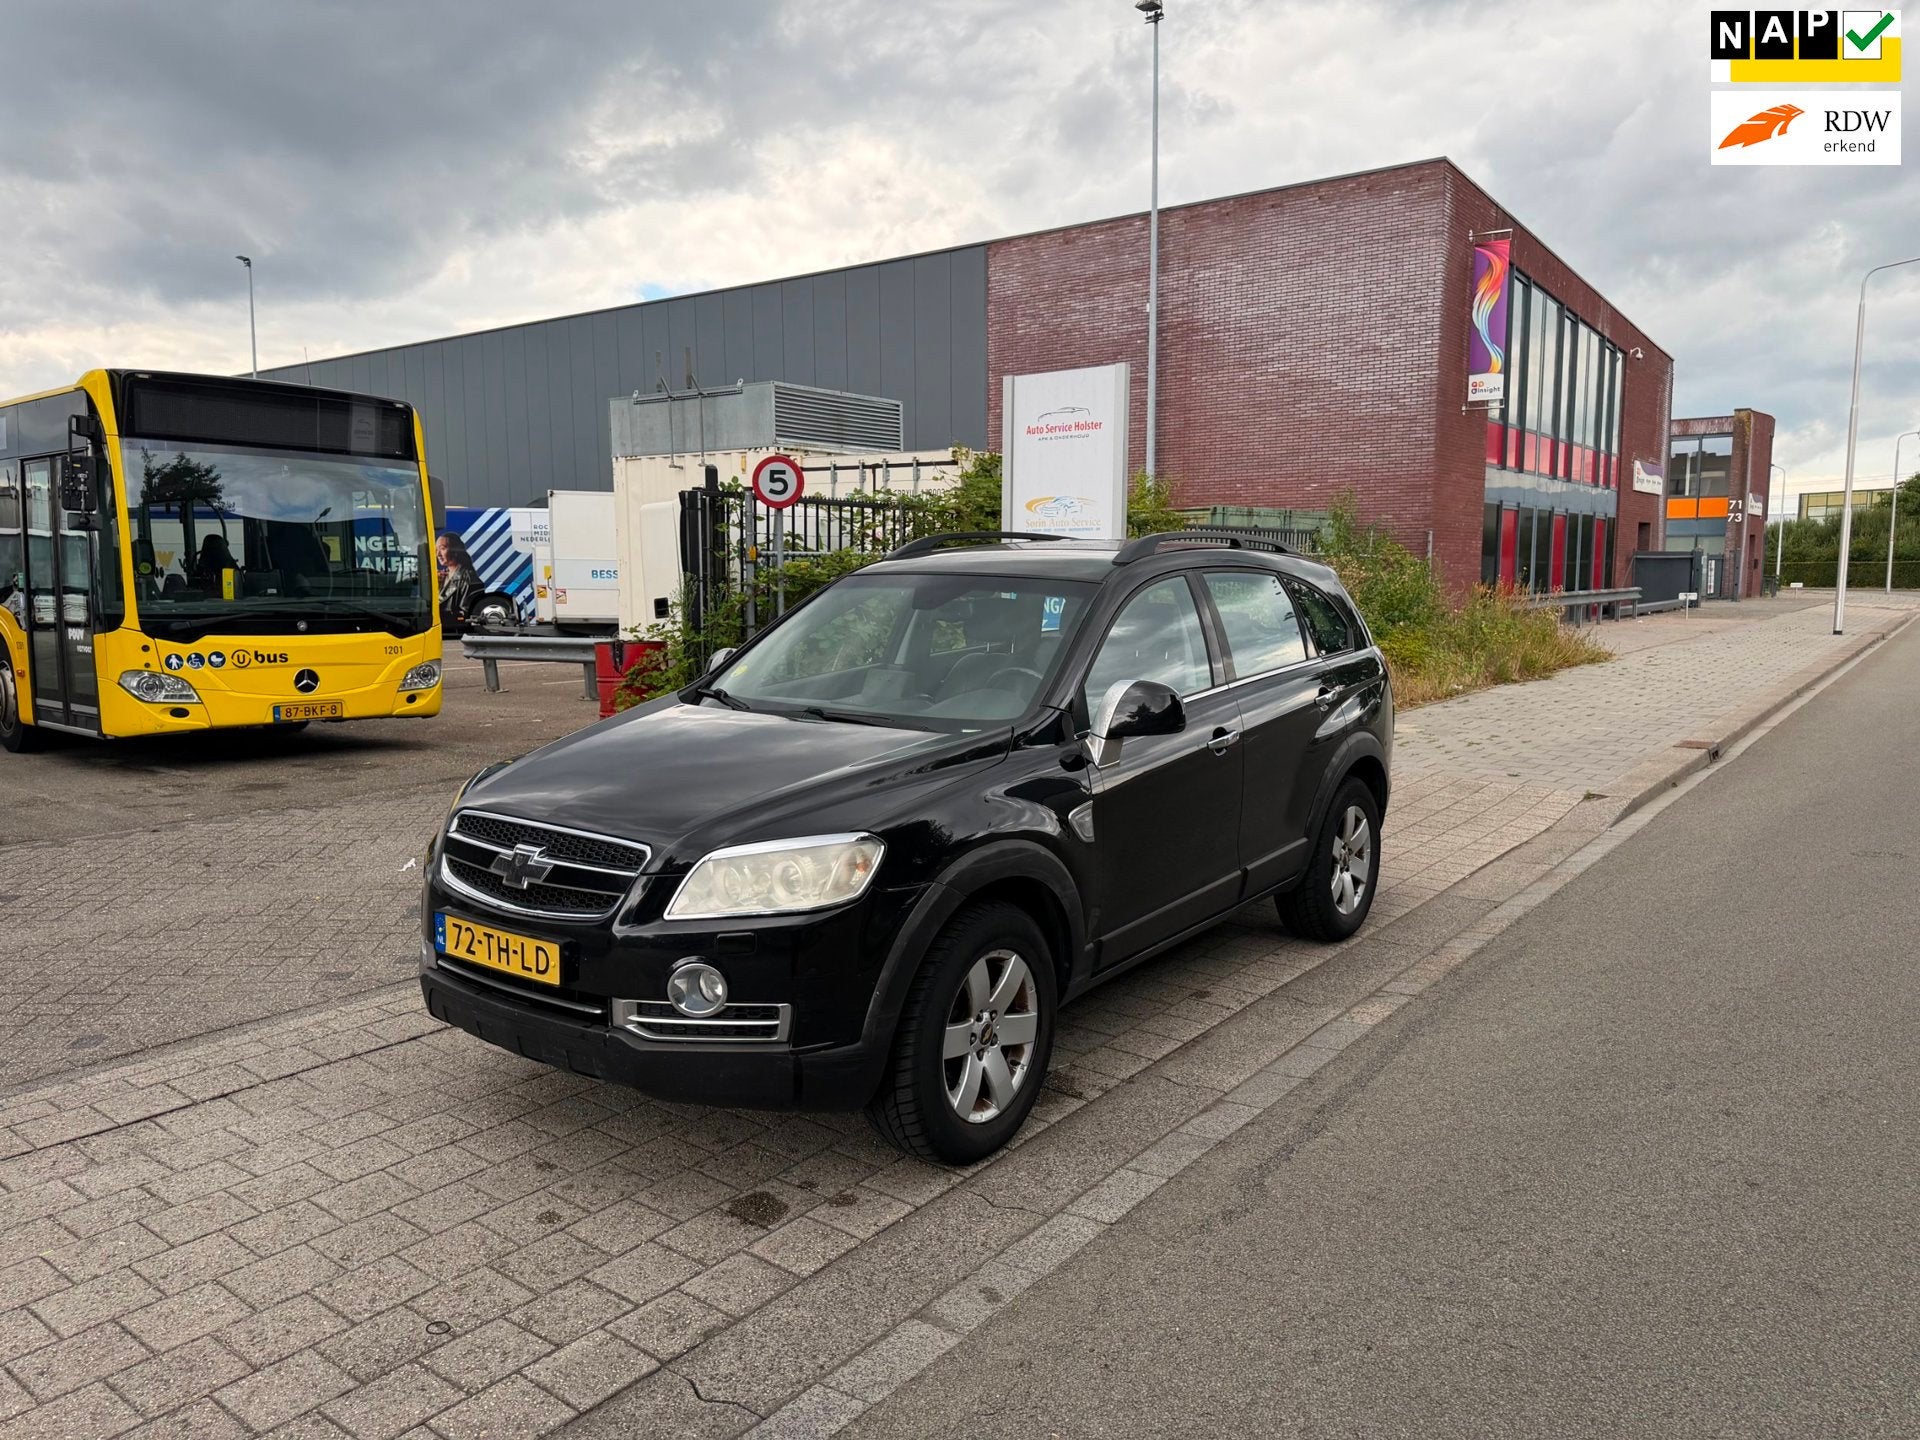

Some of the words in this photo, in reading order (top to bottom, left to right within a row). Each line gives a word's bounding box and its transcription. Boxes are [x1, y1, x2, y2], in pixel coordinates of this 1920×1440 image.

[1026, 425, 1044, 435] Auto
[1045, 422, 1072, 434] Service
[1074, 420, 1103, 431] Holster
[769, 470, 788, 495] 5
[1729, 500, 1743, 510] 71
[1727, 513, 1742, 523] 73
[253, 650, 289, 664] bus
[384, 645, 403, 655] 1201
[285, 704, 338, 719] 87-BKF-8
[452, 922, 550, 975] 72-TH-LD
